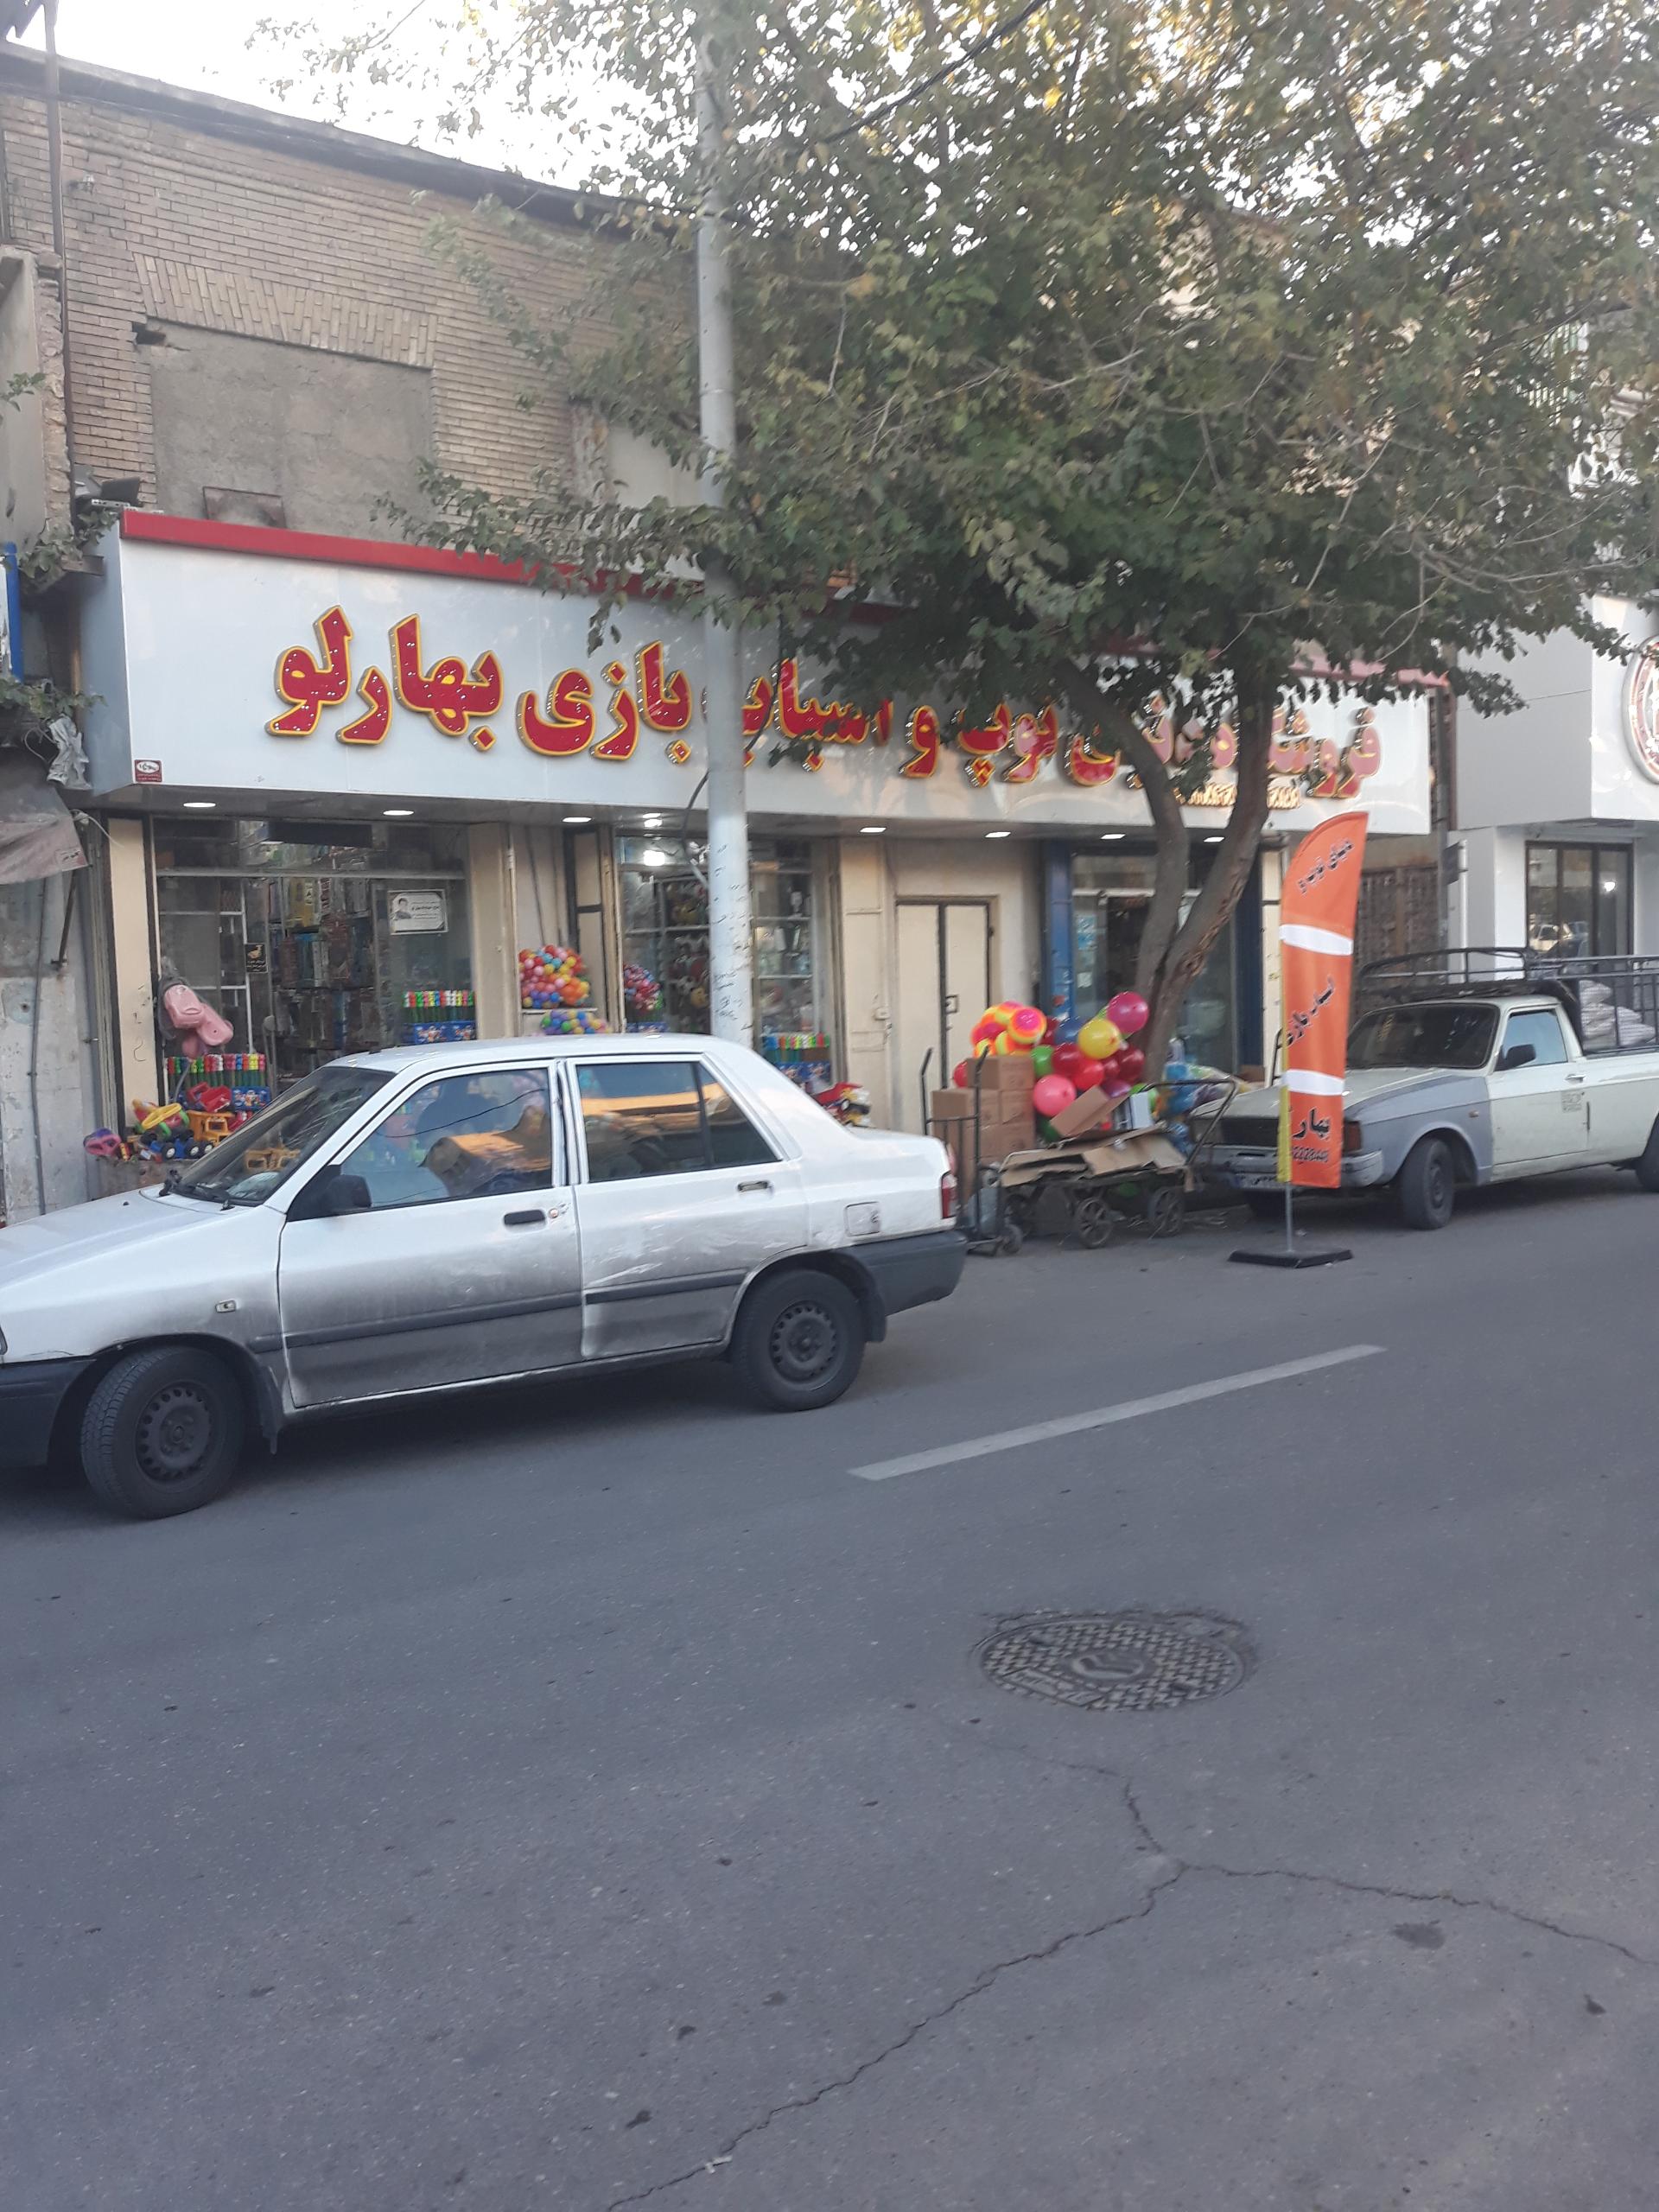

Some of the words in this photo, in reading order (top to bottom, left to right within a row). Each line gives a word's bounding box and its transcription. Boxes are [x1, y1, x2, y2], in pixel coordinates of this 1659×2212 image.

[266, 604, 504, 752] بهارلو
[518, 640, 690, 764] بازی
[899, 704, 940, 778] و
[1288, 1106, 1331, 1140] بهار
